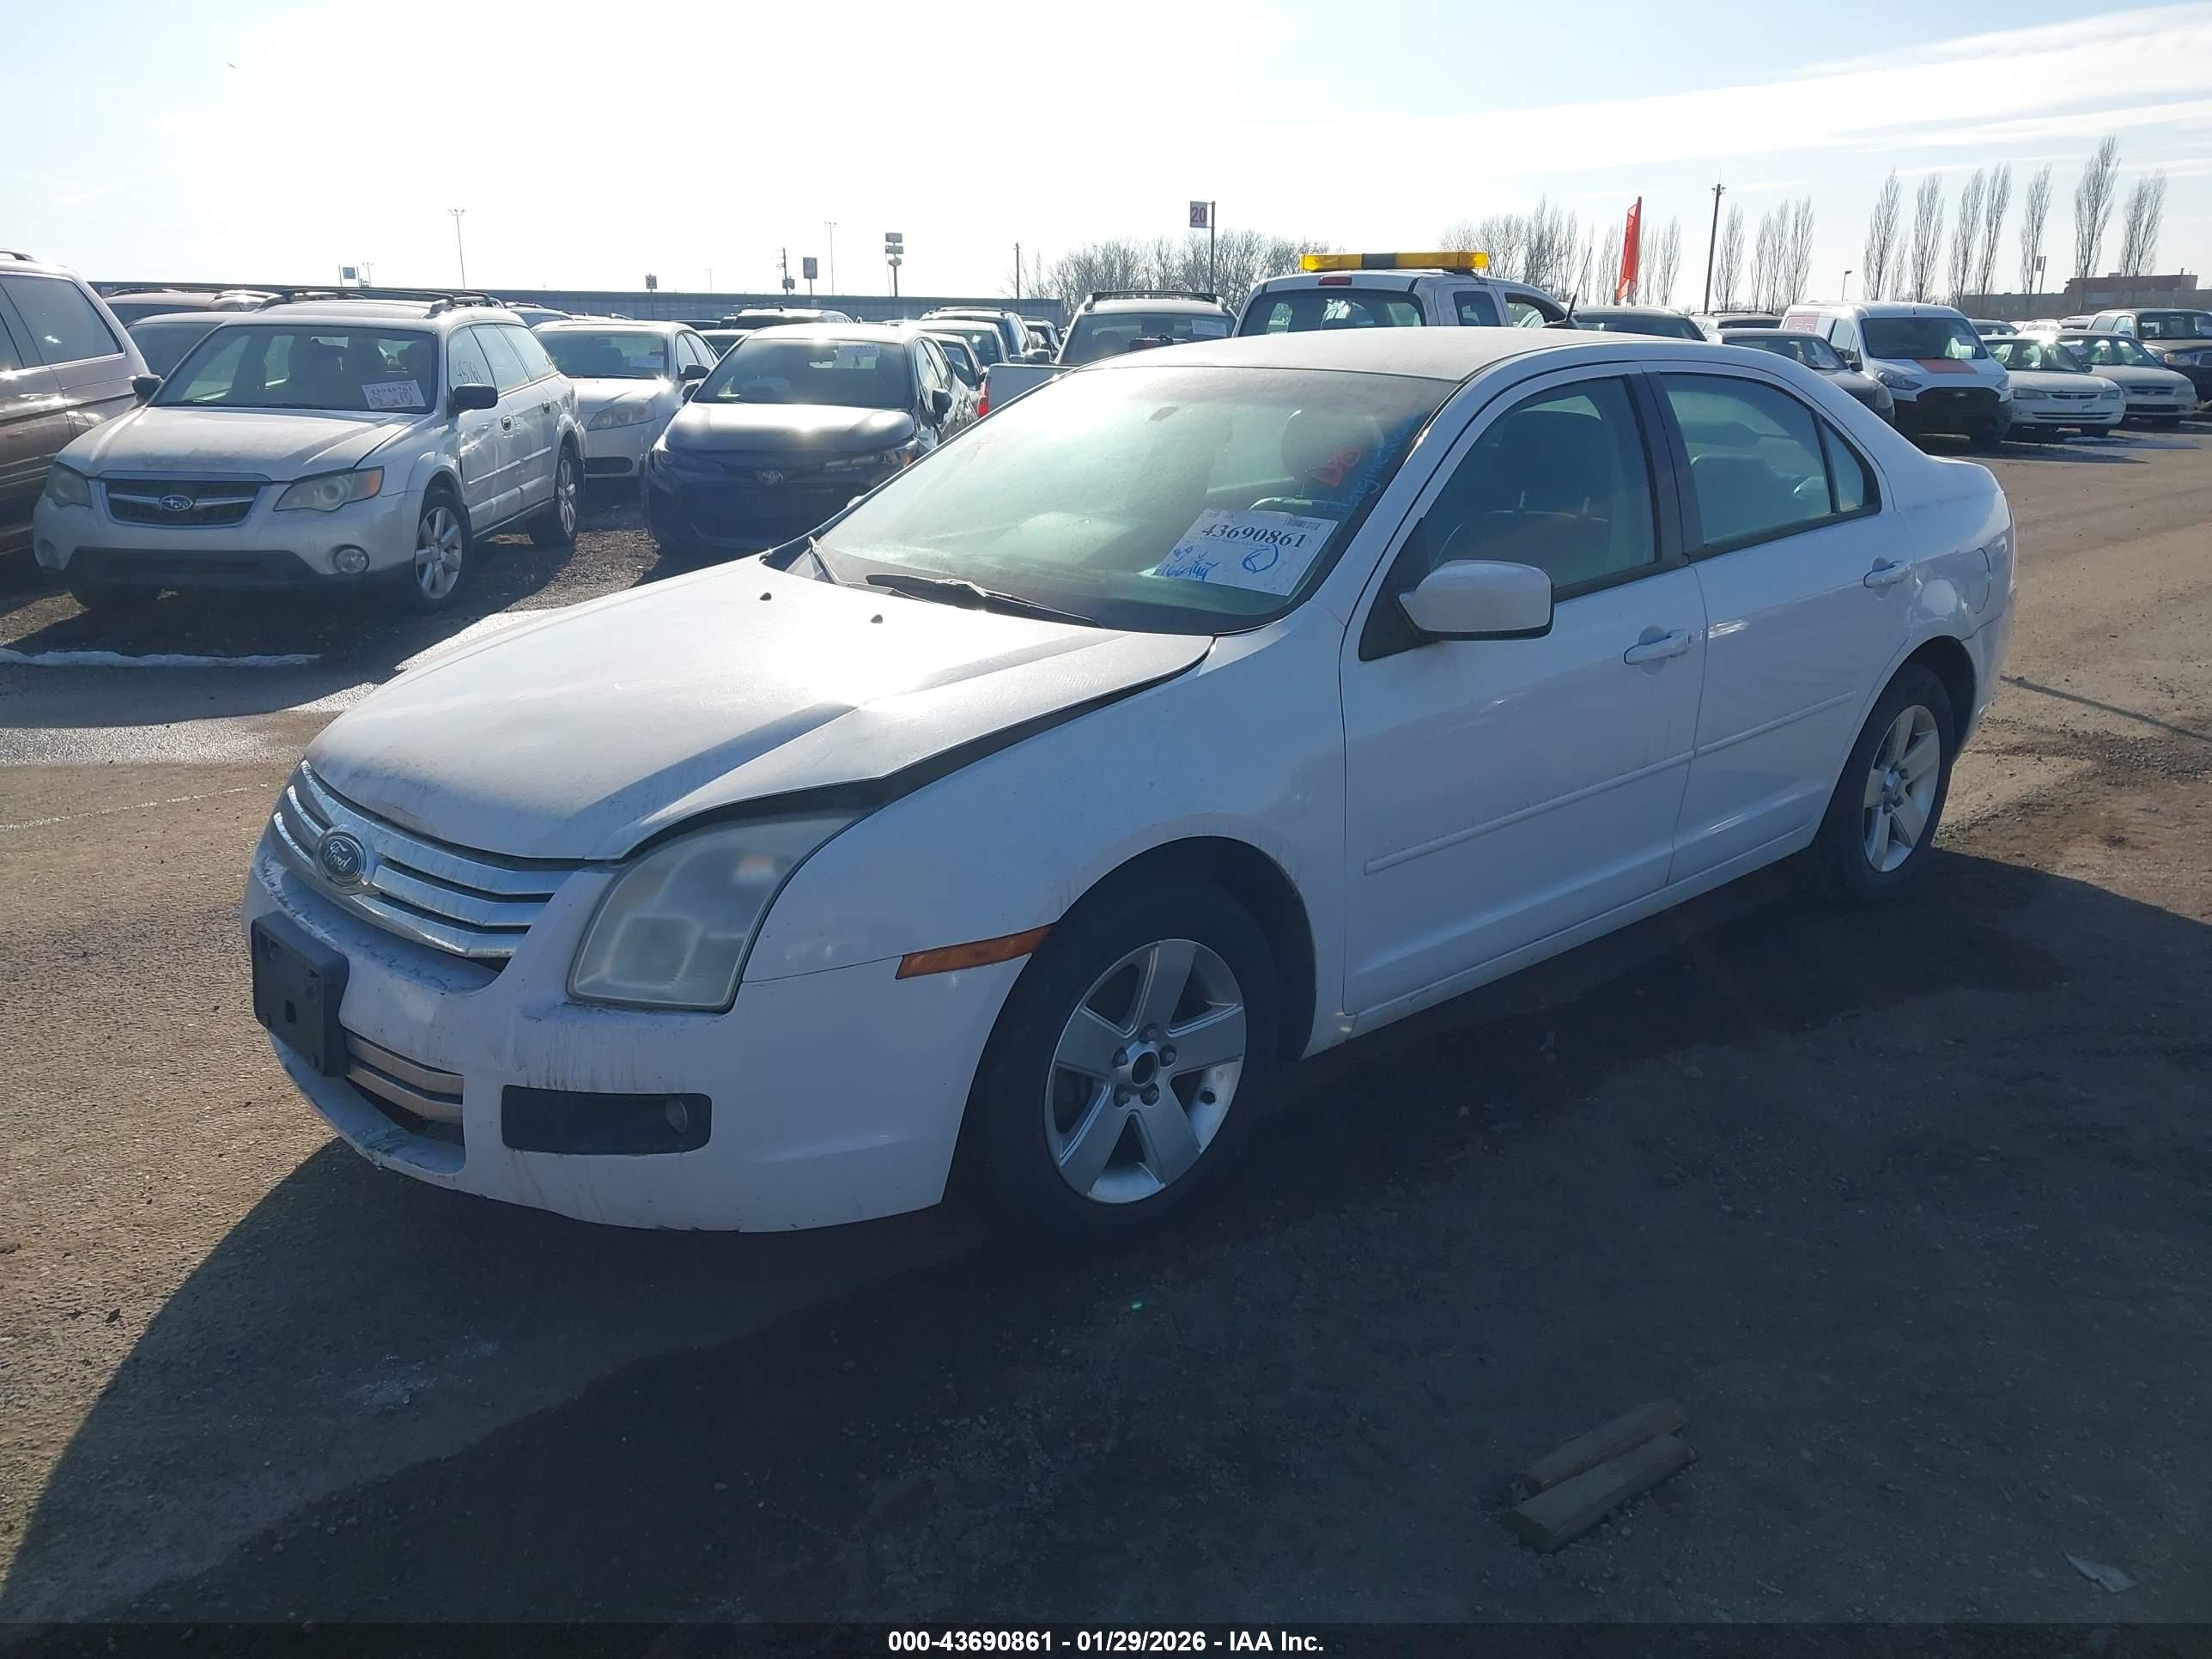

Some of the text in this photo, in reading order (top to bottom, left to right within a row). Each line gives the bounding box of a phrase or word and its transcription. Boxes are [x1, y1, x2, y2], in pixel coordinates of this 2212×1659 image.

[1191, 206, 1206, 223] 20
[1202, 523, 1307, 548] 43690861
[328, 841, 352, 872] Ford
